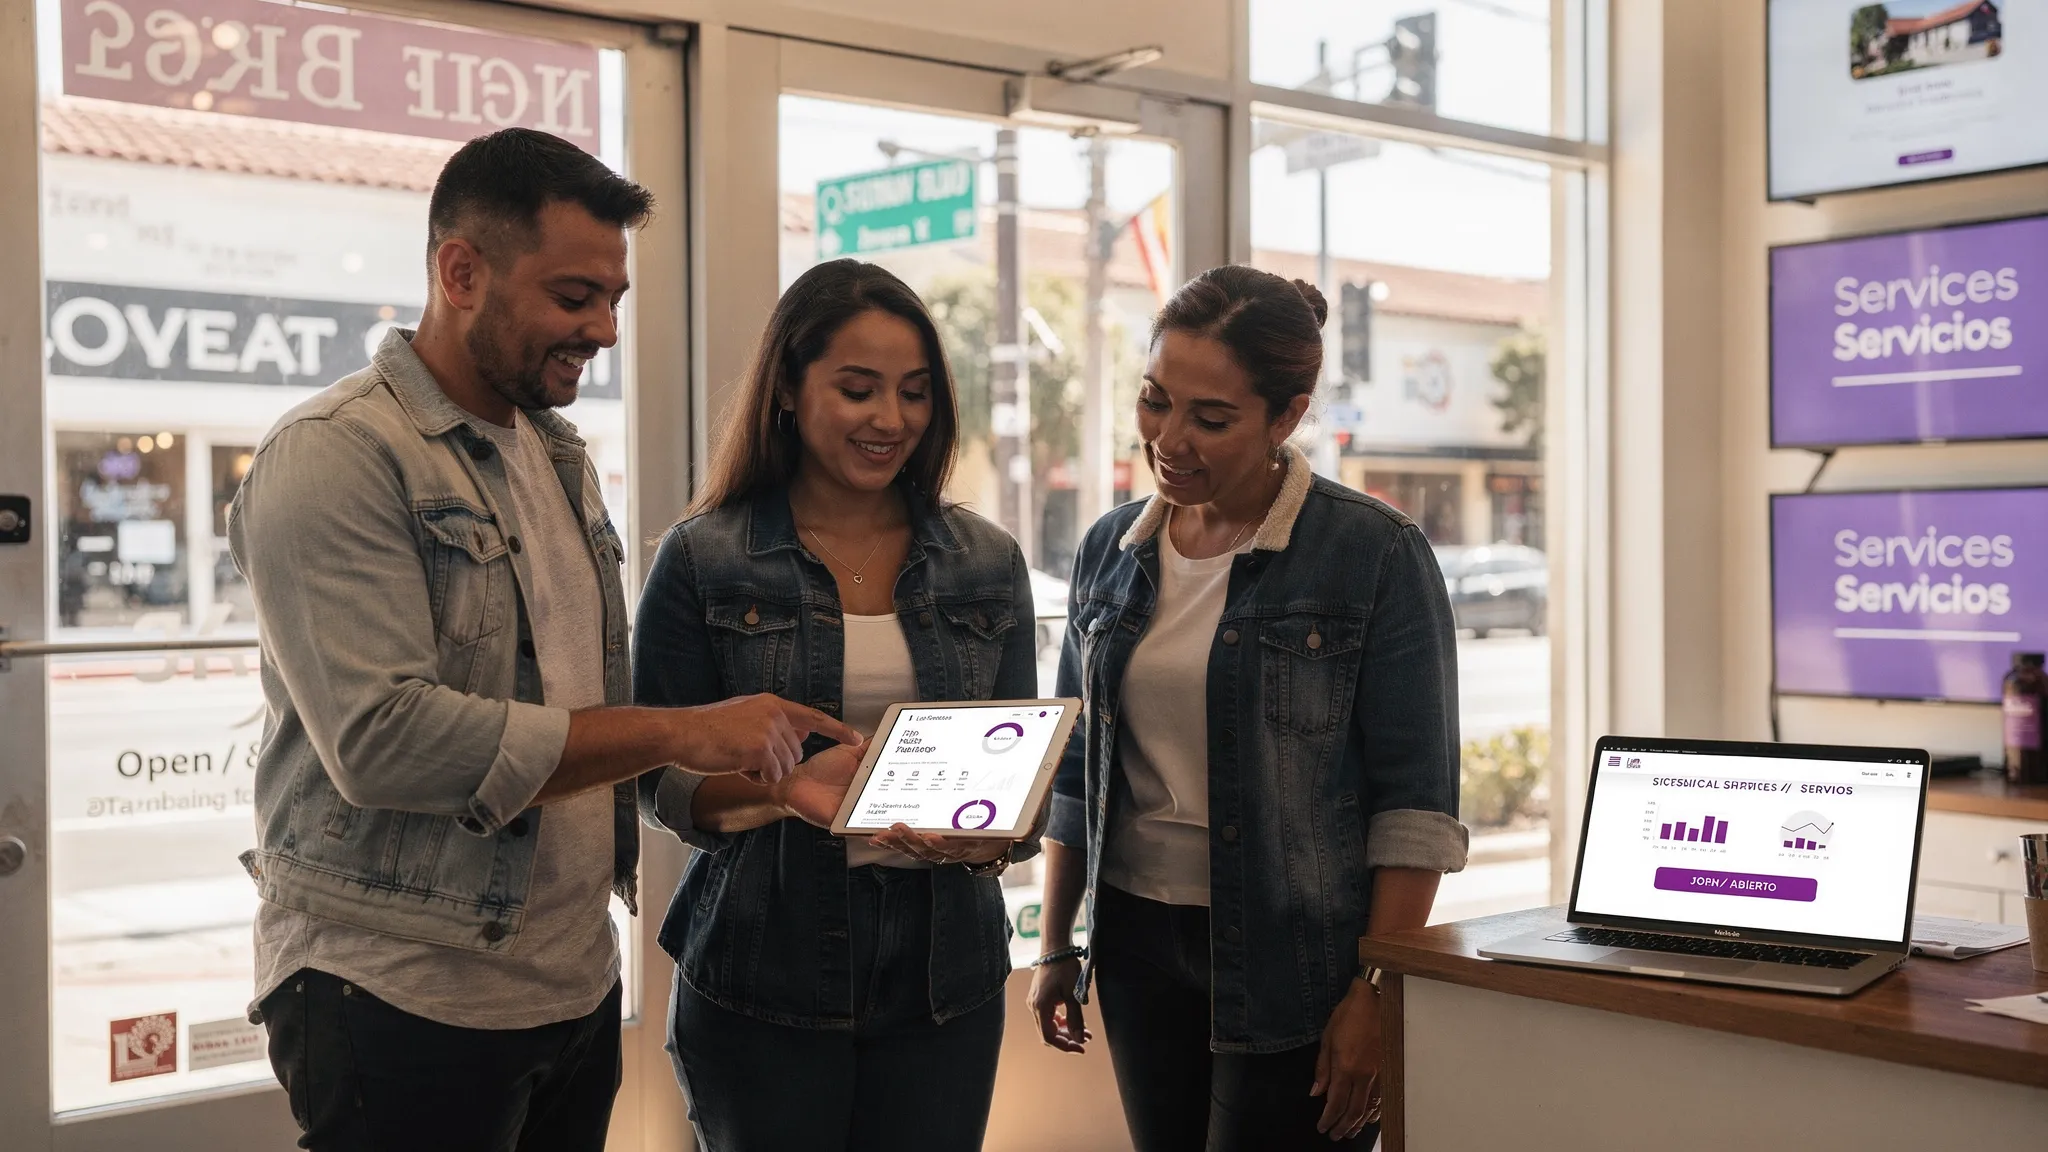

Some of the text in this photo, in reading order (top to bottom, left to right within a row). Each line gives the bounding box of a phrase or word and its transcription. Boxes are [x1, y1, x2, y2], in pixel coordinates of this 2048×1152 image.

[1834, 264, 2020, 317] Services
[46, 296, 338, 377] OVEAT
[1832, 310, 2014, 362] Servicios
[1834, 525, 2016, 568] Services
[1834, 573, 2012, 616] Servicios
[117, 751, 212, 783] Open
[1800, 784, 1854, 796] SERVIOS
[1729, 879, 1777, 892] ABIERTO
